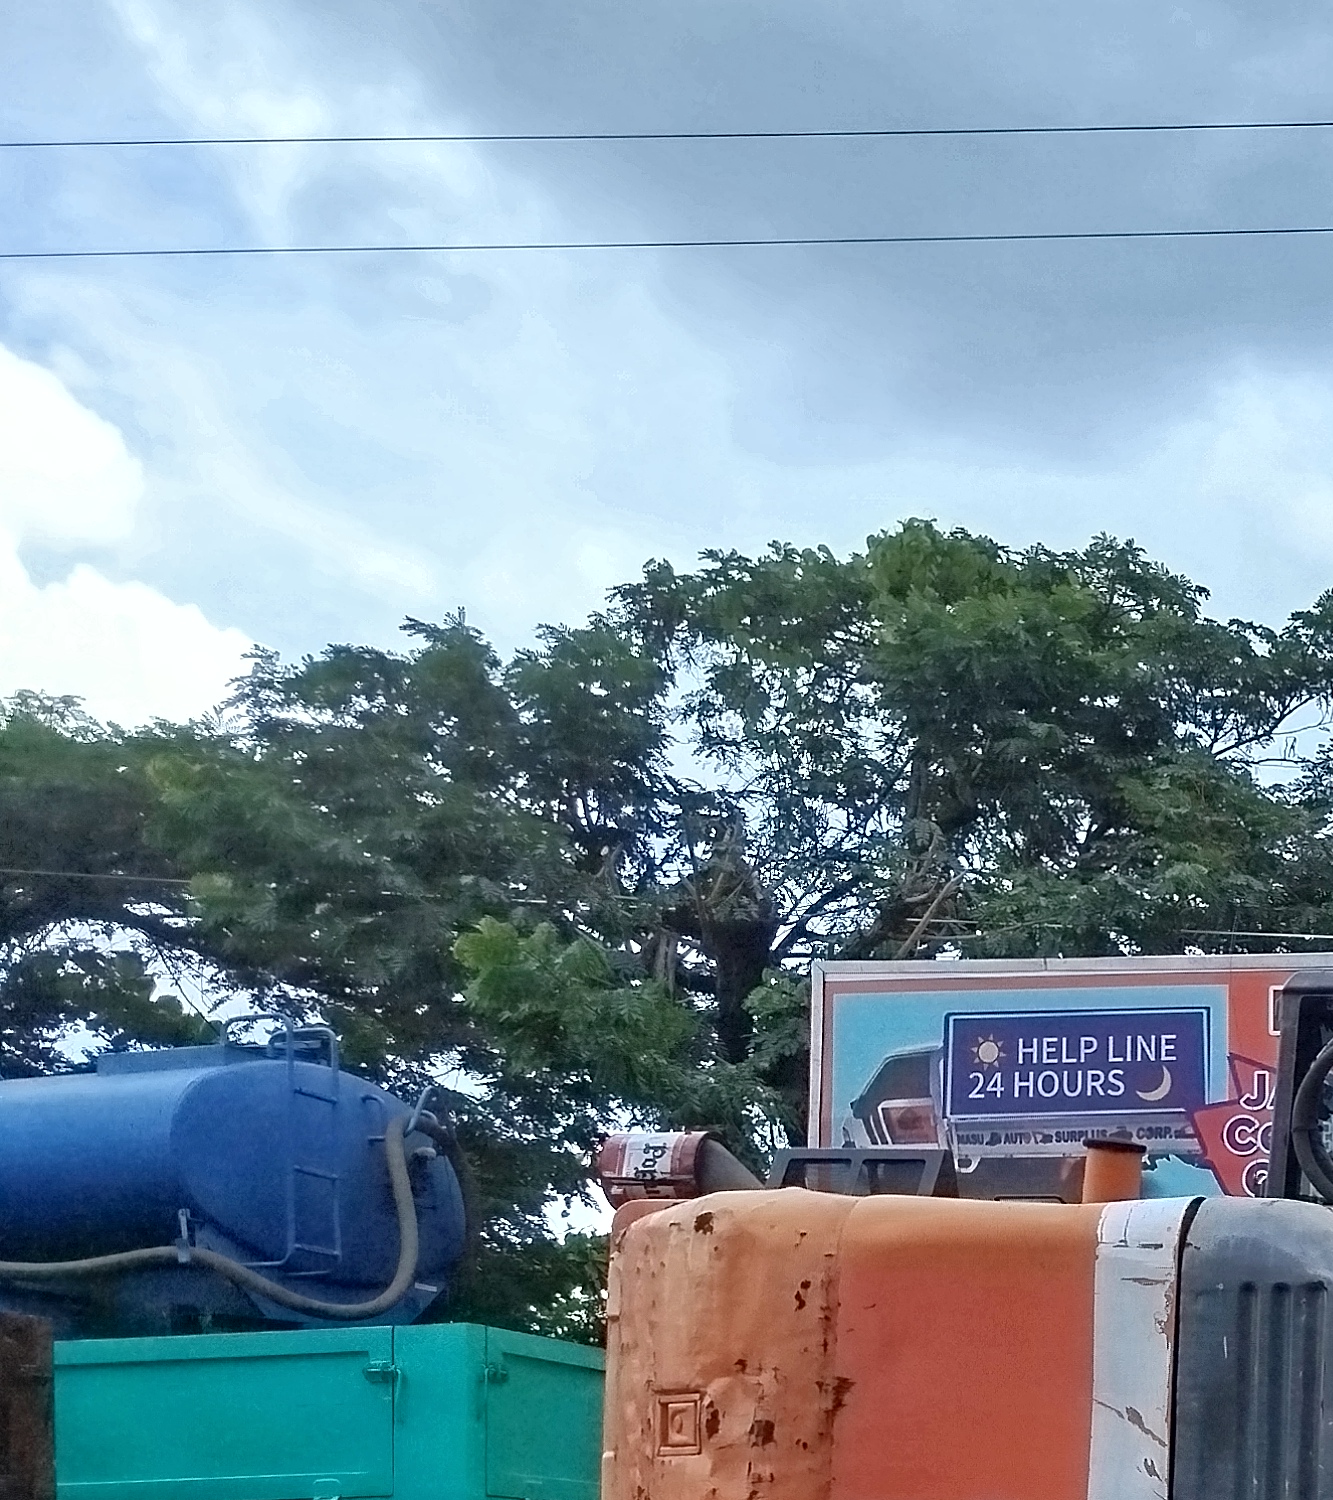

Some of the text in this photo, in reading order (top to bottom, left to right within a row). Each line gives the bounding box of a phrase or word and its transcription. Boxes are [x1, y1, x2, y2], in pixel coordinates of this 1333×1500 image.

[1017, 1034, 1177, 1065] HELP LINE
[968, 1069, 1126, 1099] 24 HOURS
[957, 1133, 985, 1145] MASU
[1054, 1129, 1109, 1144] SURPLUS
